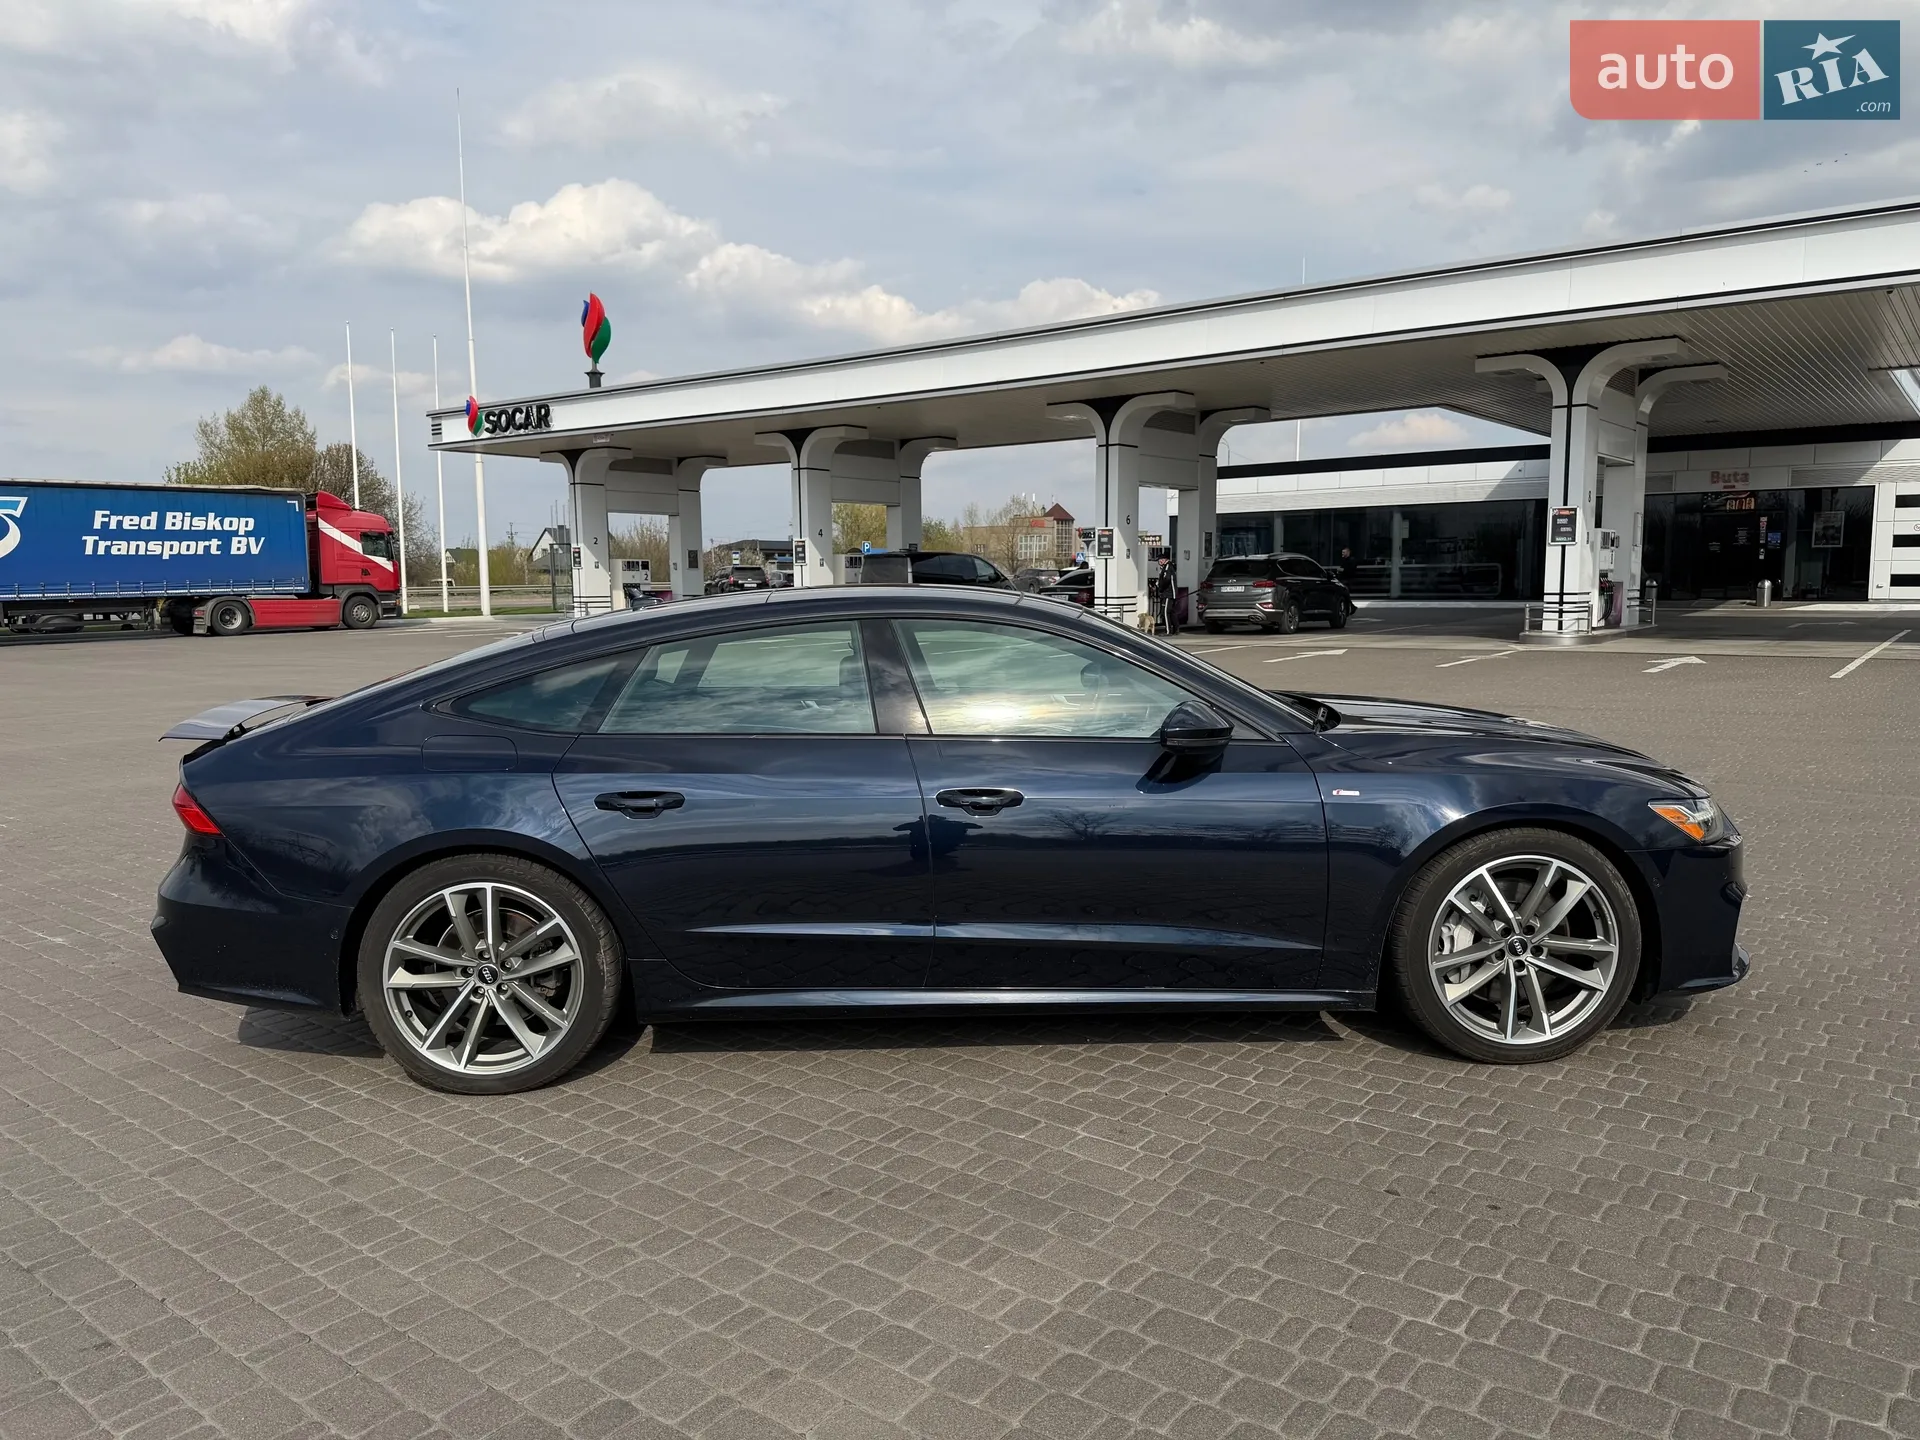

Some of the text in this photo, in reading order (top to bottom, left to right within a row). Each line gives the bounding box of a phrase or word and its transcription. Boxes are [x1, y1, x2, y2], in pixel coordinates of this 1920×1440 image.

[484, 403, 551, 434] SOCAR
[93, 510, 255, 535] Fred Biskop
[1126, 515, 1131, 525] 6
[818, 528, 823, 537] 4
[82, 535, 266, 560] Transport BV
[864, 542, 870, 552] P
